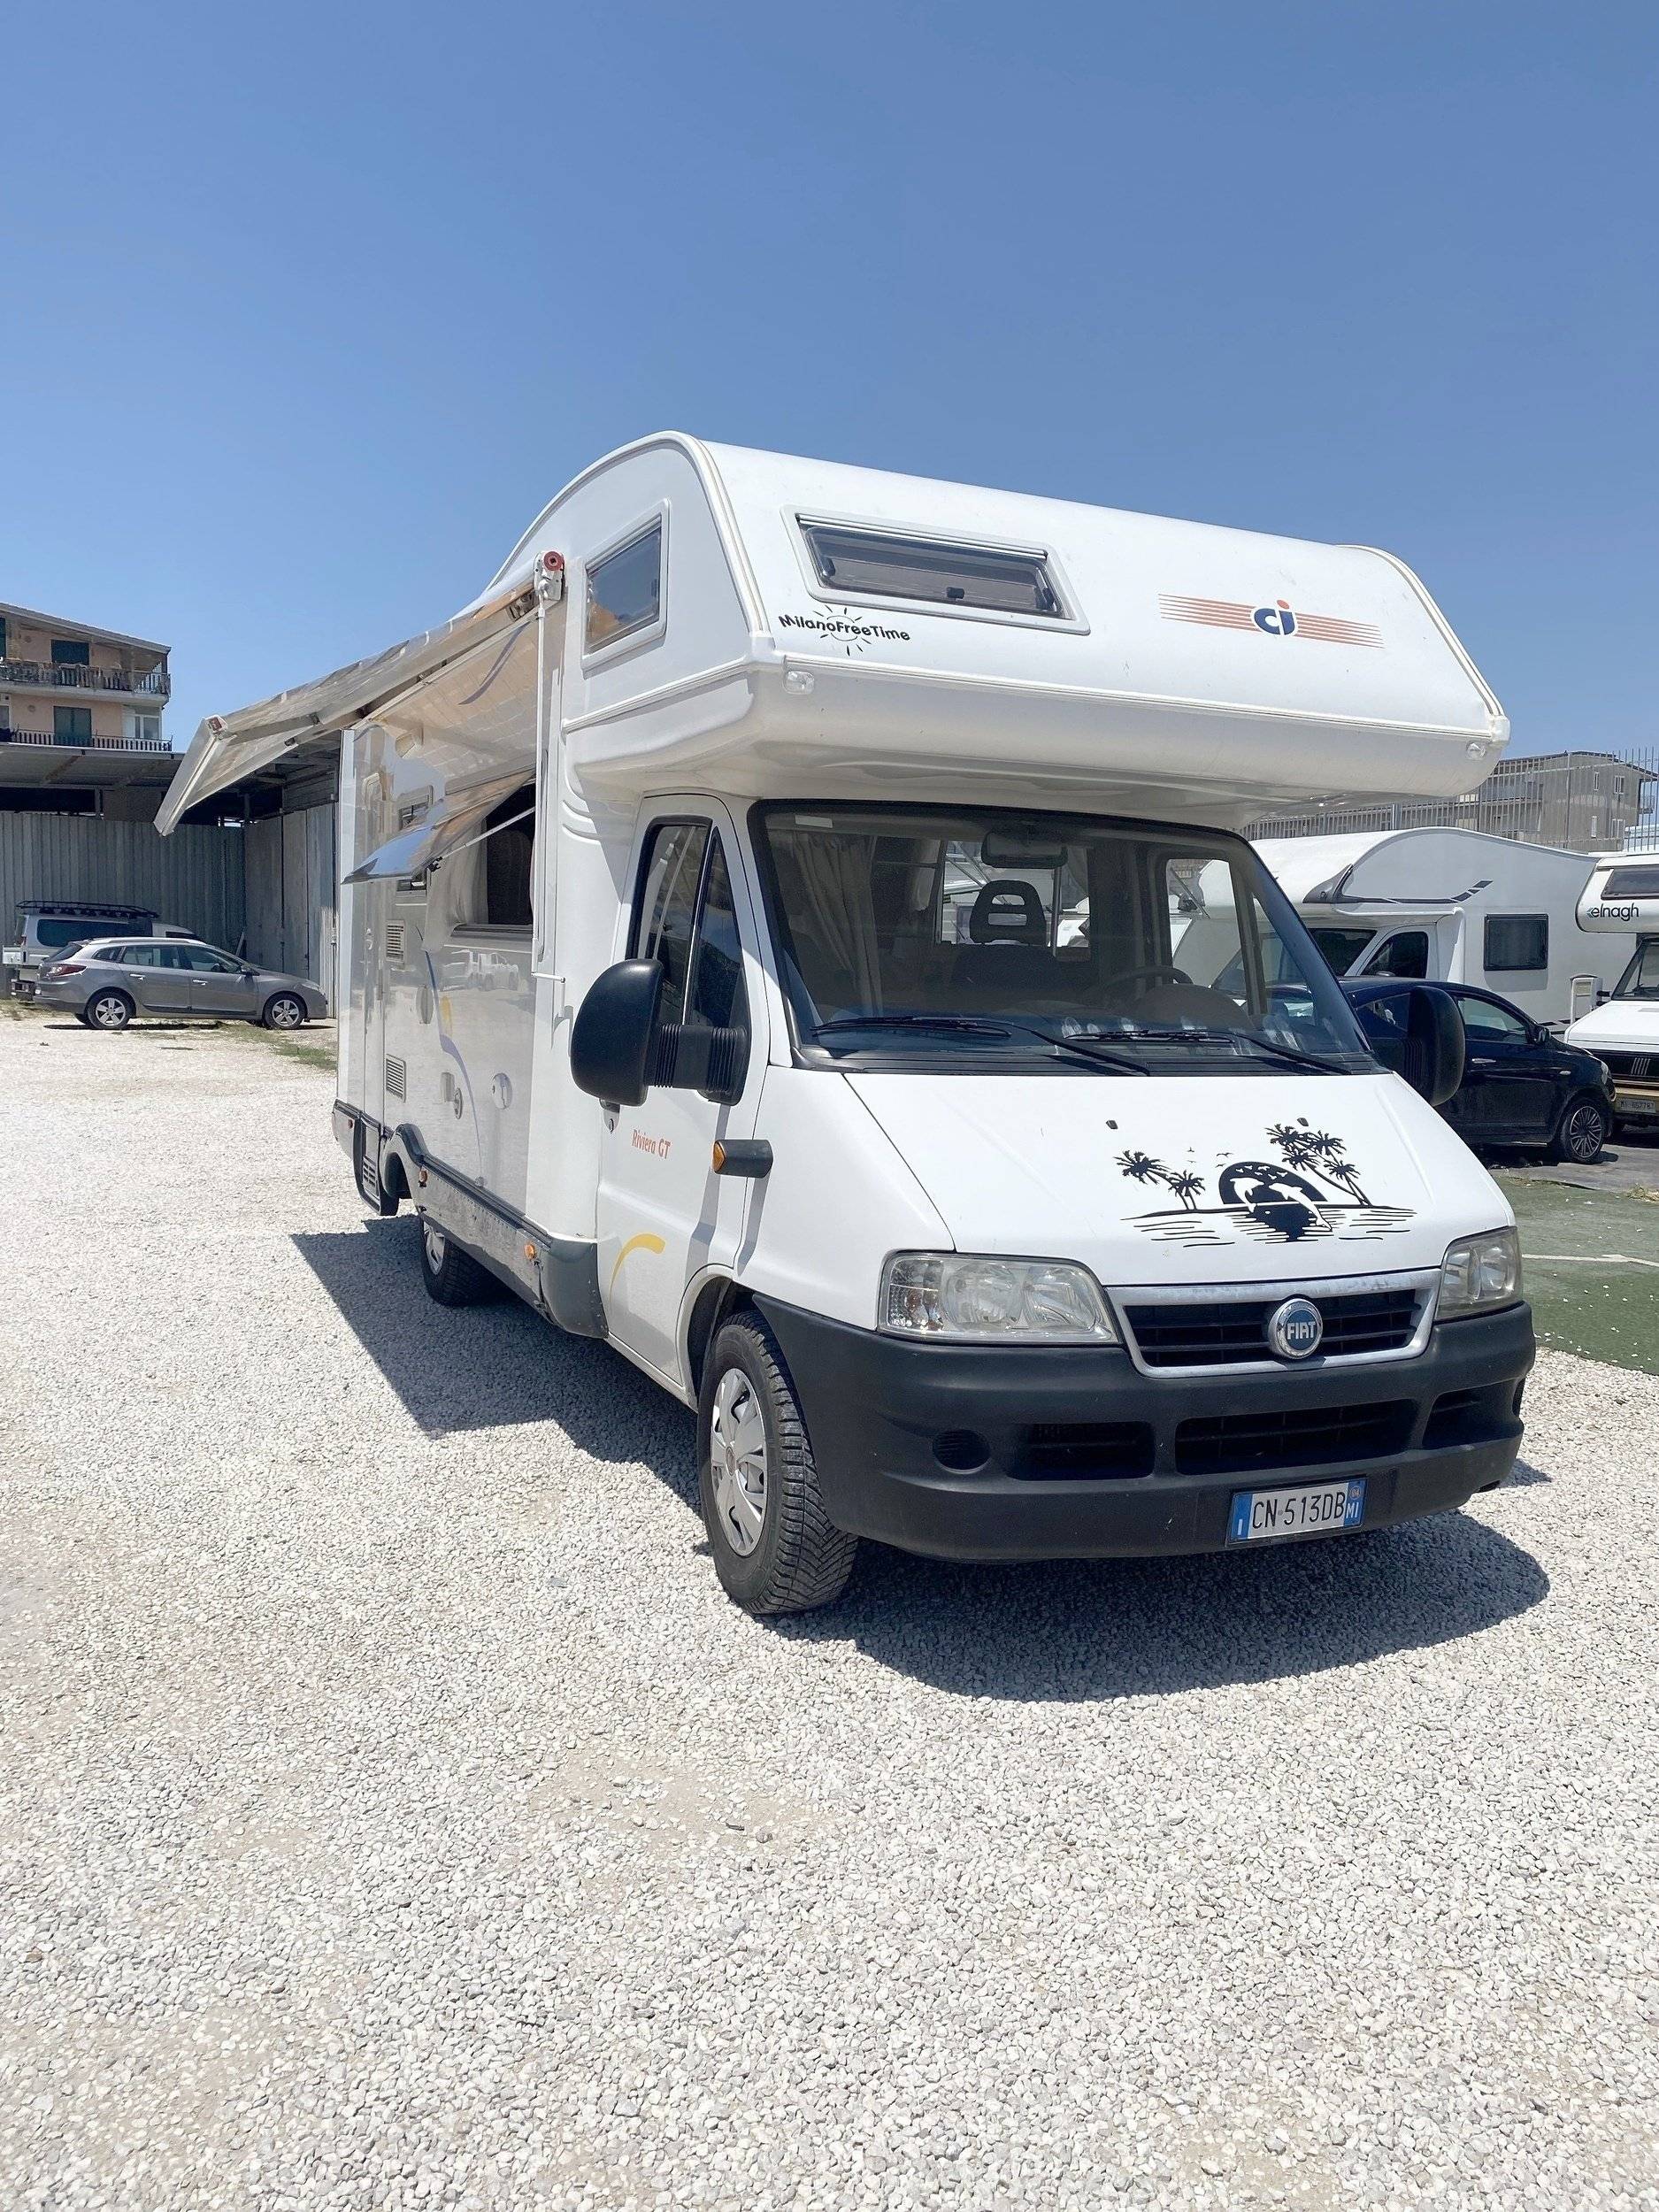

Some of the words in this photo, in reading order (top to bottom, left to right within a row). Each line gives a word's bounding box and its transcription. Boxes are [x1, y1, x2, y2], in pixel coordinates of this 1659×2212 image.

[778, 614, 910, 641] MilanoFreeTime
[1590, 902, 1640, 921] elnagh
[632, 1129, 657, 1154] Riviera
[658, 1139, 671, 1159] GT
[1287, 1322, 1316, 1340] FIAT
[1252, 1499, 1278, 1529] CN
[1283, 1492, 1346, 1525] 513DB
[1346, 1502, 1359, 1519] MI
